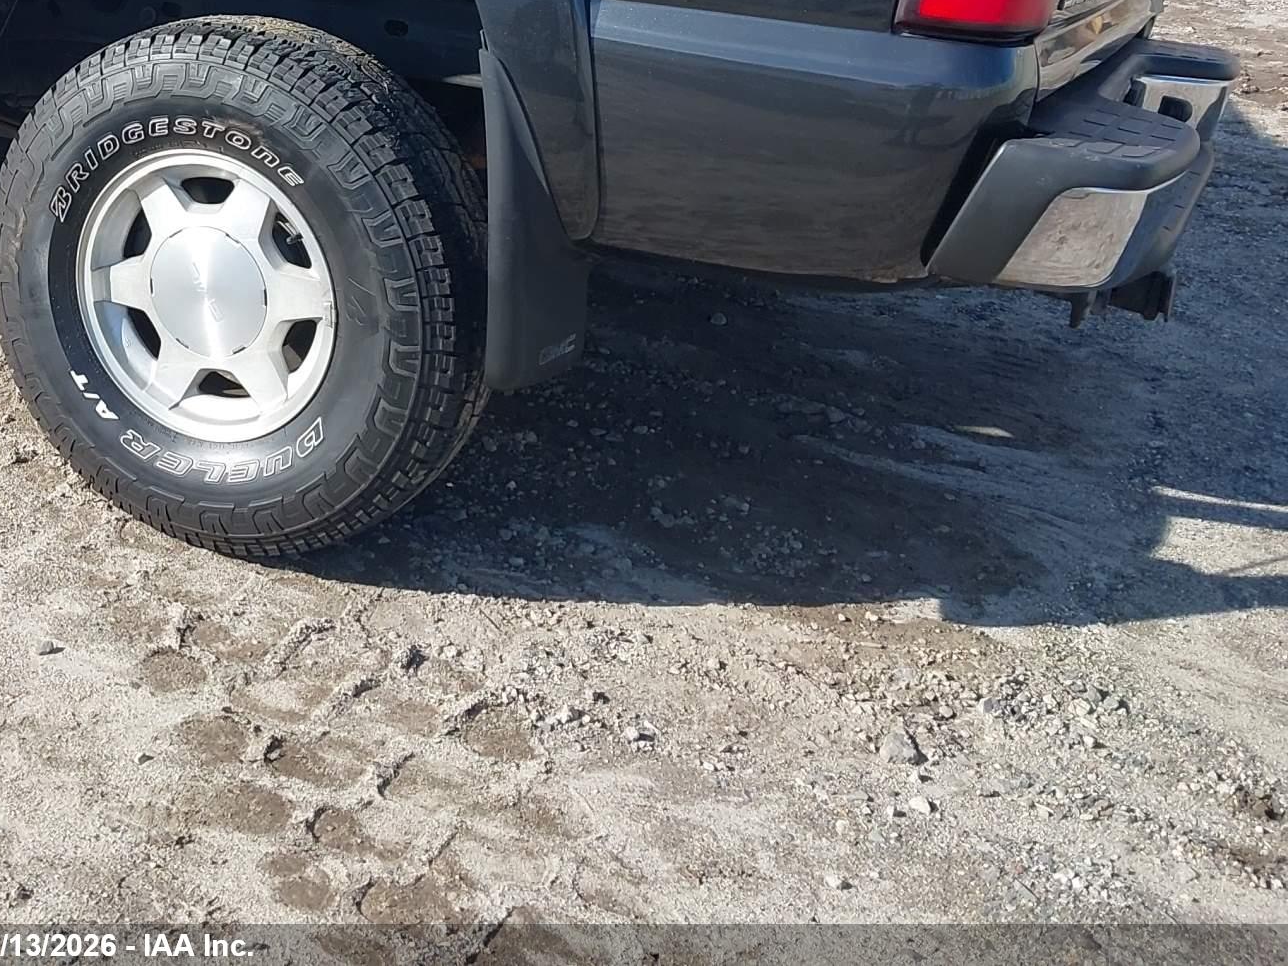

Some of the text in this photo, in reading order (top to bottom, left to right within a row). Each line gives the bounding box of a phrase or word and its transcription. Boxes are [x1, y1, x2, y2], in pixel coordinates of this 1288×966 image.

[49, 116, 305, 223] BRIDGESTONE
[69, 369, 121, 421] A/T
[119, 416, 325, 483] DUELER
